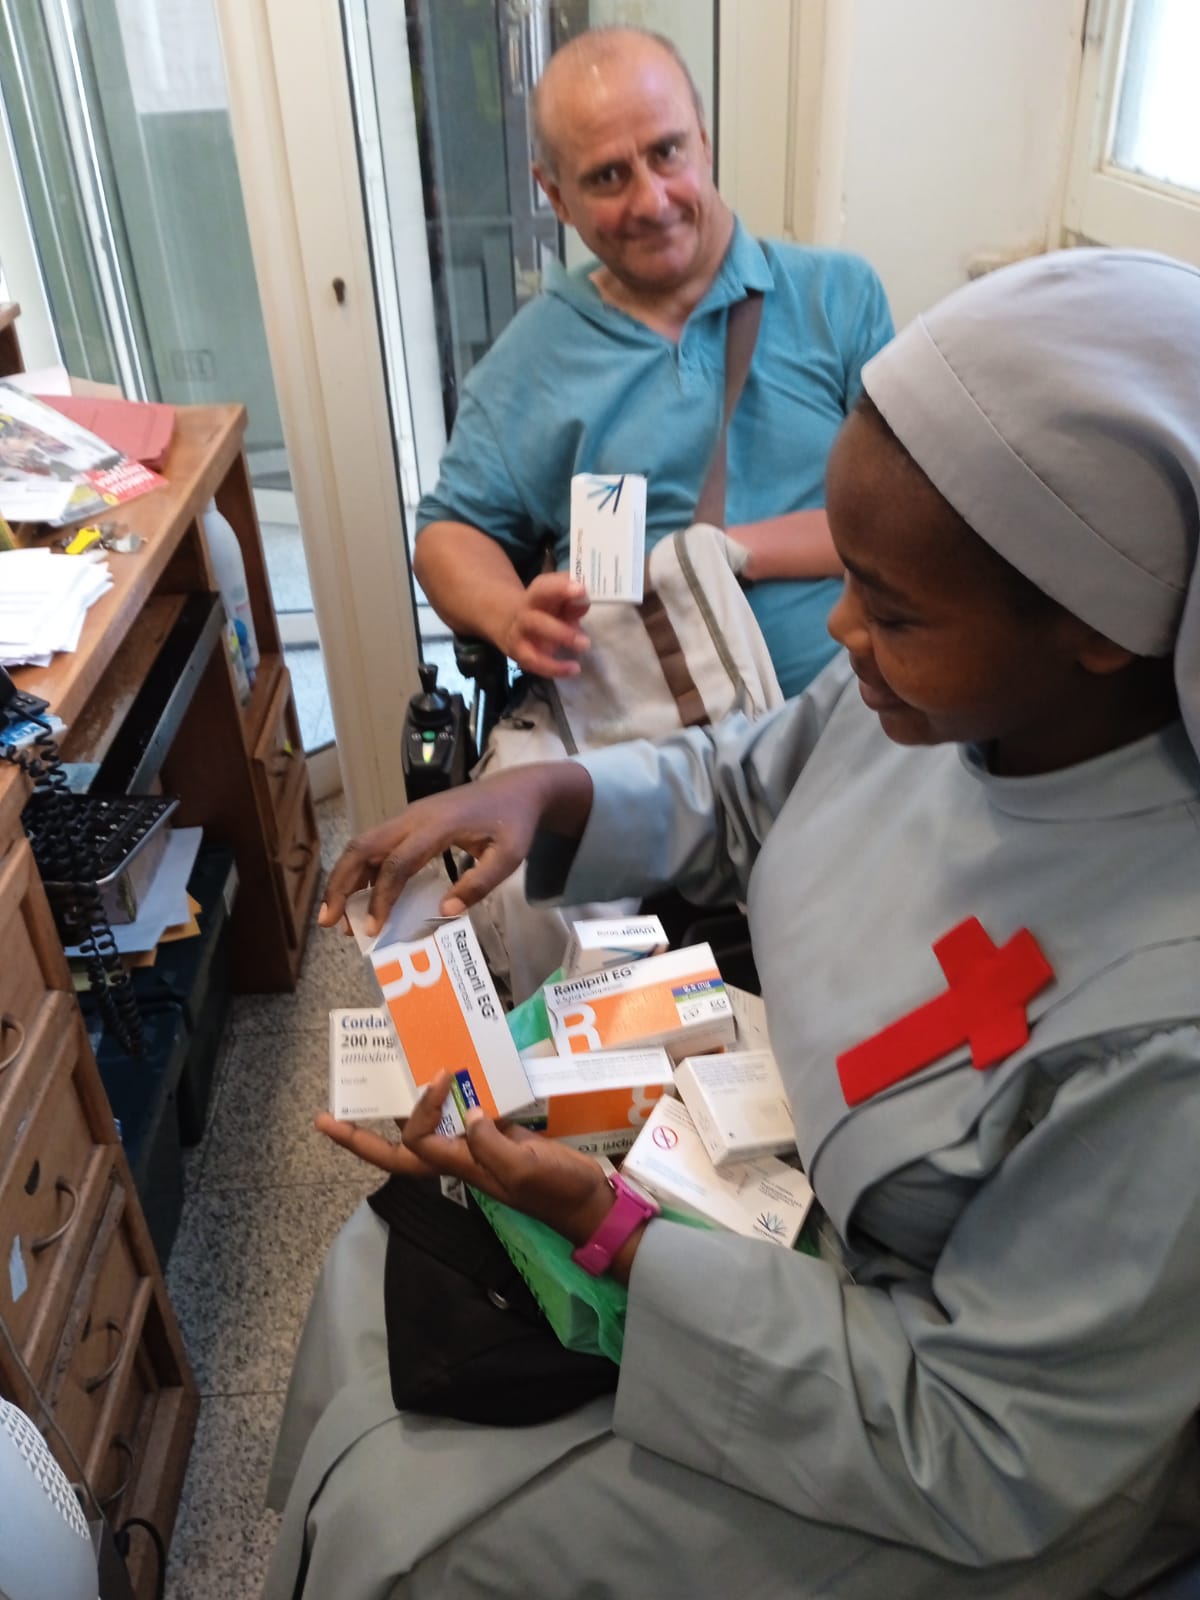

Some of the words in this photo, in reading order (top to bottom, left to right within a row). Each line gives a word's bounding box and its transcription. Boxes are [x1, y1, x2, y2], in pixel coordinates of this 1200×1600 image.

[453, 928, 486, 992] Ramipril
[477, 994, 495, 1019] EG
[553, 972, 608, 997] Ramipril
[612, 966, 633, 981] EG
[341, 1033, 368, 1048] 200
[372, 1035, 394, 1049] mg
